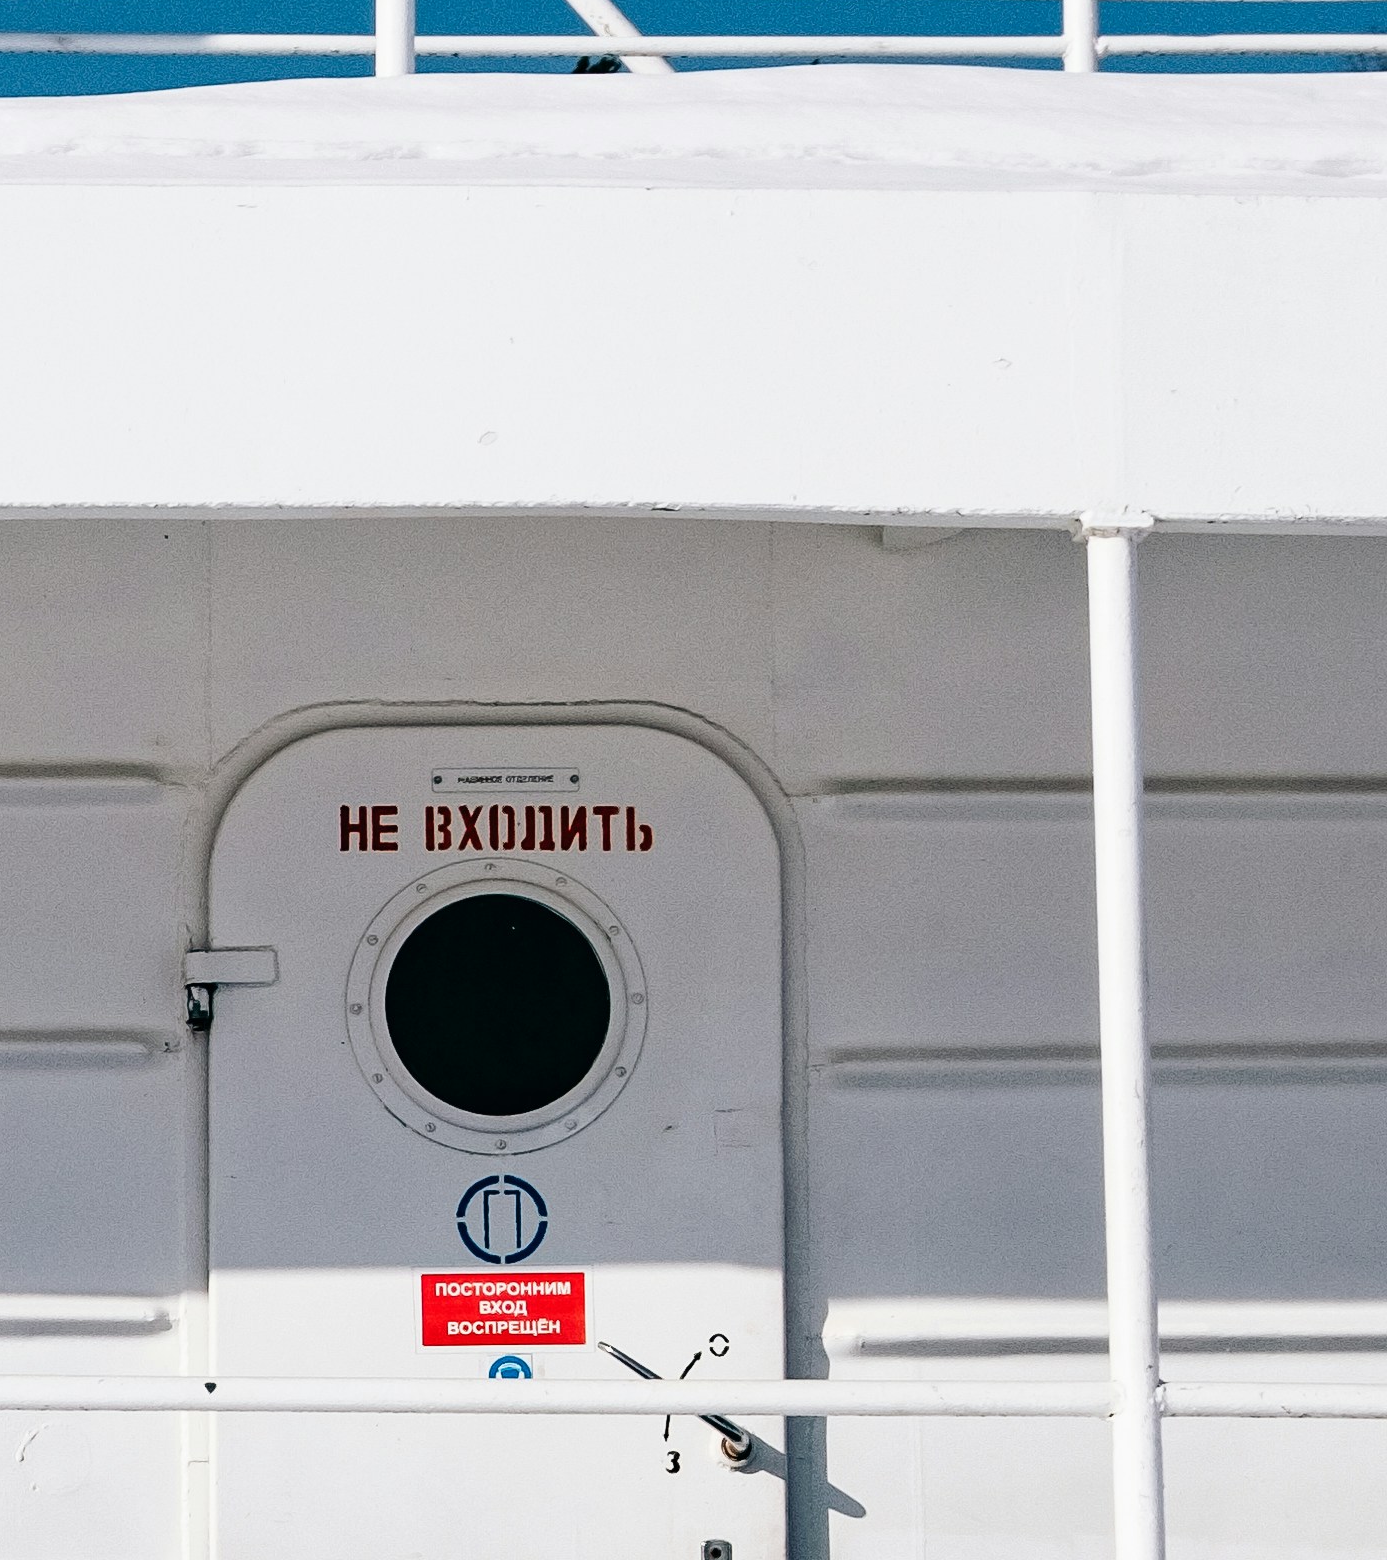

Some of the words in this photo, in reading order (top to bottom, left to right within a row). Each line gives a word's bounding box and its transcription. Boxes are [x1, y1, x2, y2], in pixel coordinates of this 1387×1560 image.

[339, 804, 399, 852] НЕ
[425, 805, 654, 852] ВХОДИТЬ
[435, 1281, 571, 1297] ПОСТОРОННИМ
[479, 1299, 528, 1317] ВХОД
[447, 1318, 561, 1337] ВОСПРЕЩЁН
